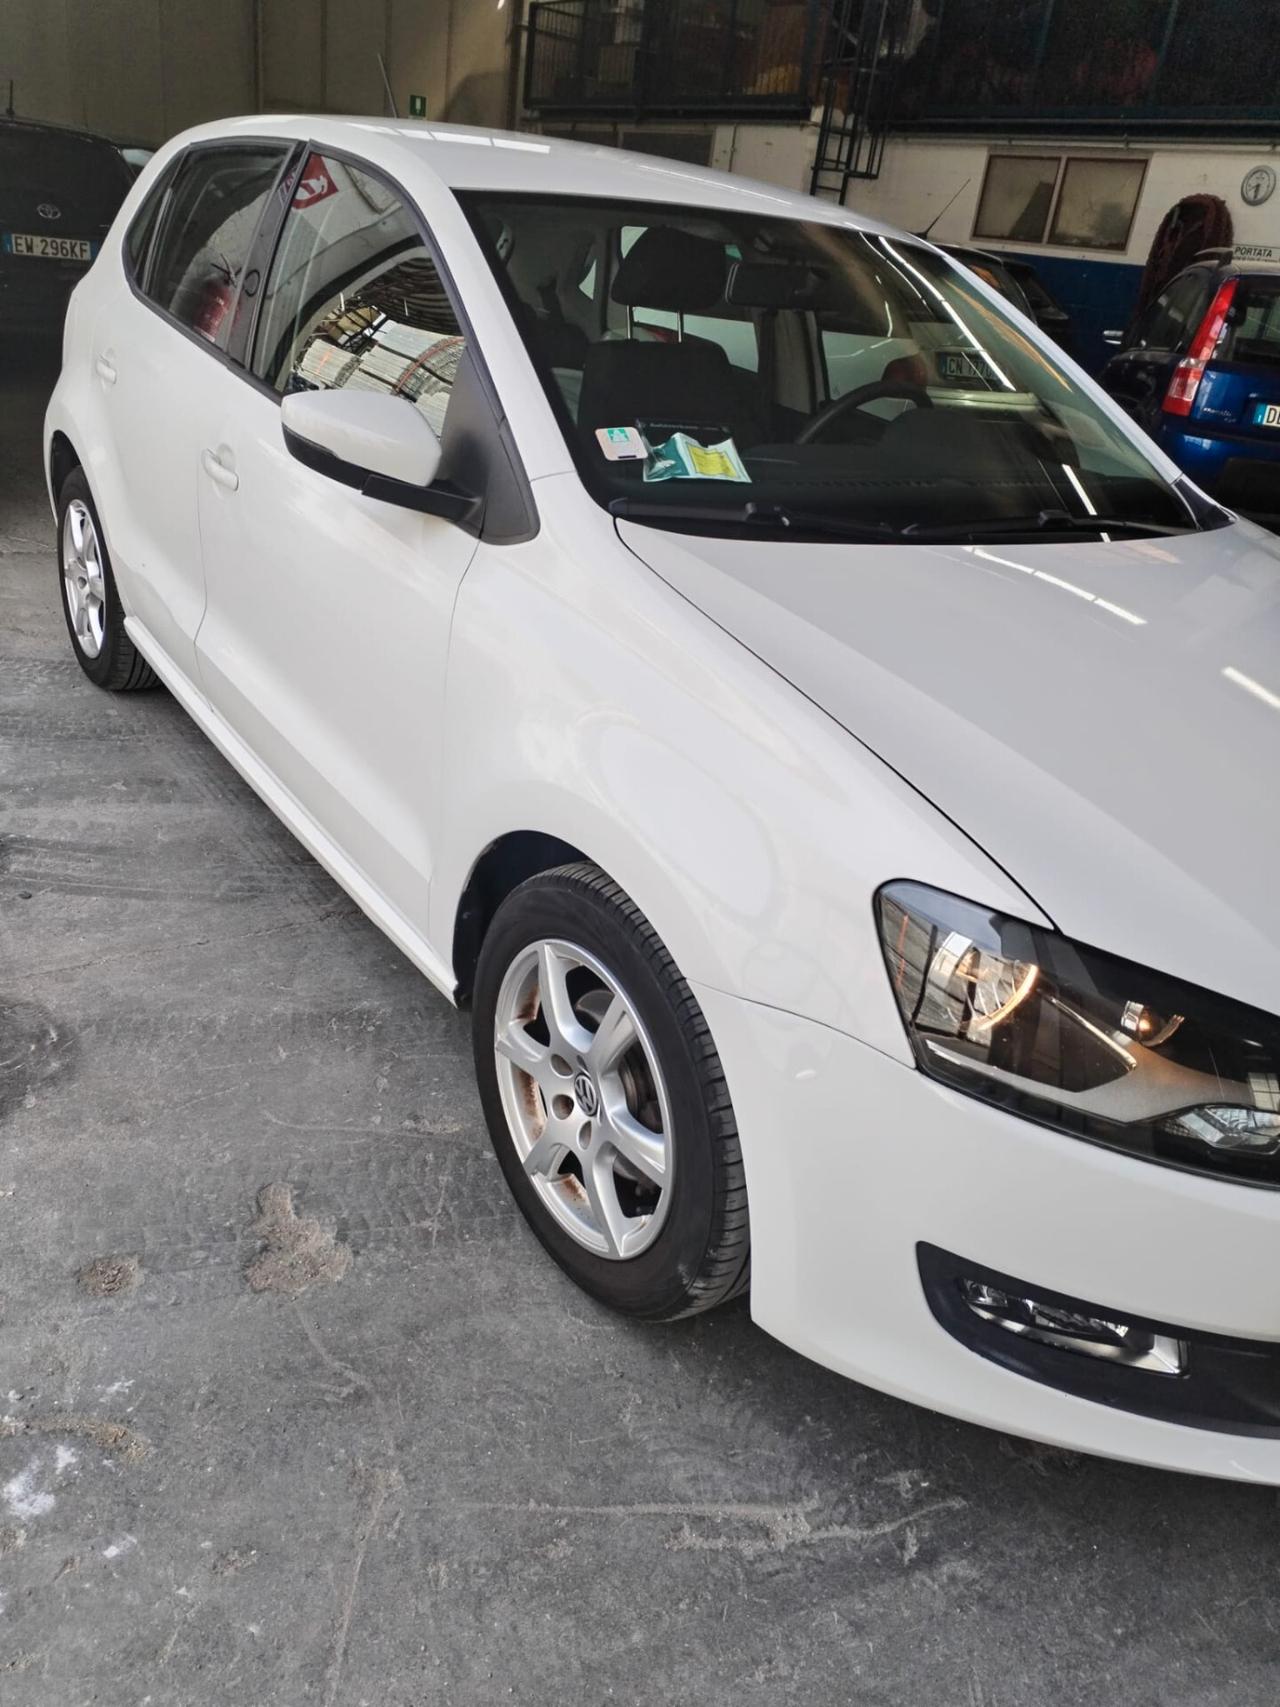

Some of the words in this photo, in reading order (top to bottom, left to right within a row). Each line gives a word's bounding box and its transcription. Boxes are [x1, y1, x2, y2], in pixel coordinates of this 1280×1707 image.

[41, 238, 88, 258] 296KF
[1235, 246, 1272, 257] PORTATA
[1266, 407, 1280, 425] D
